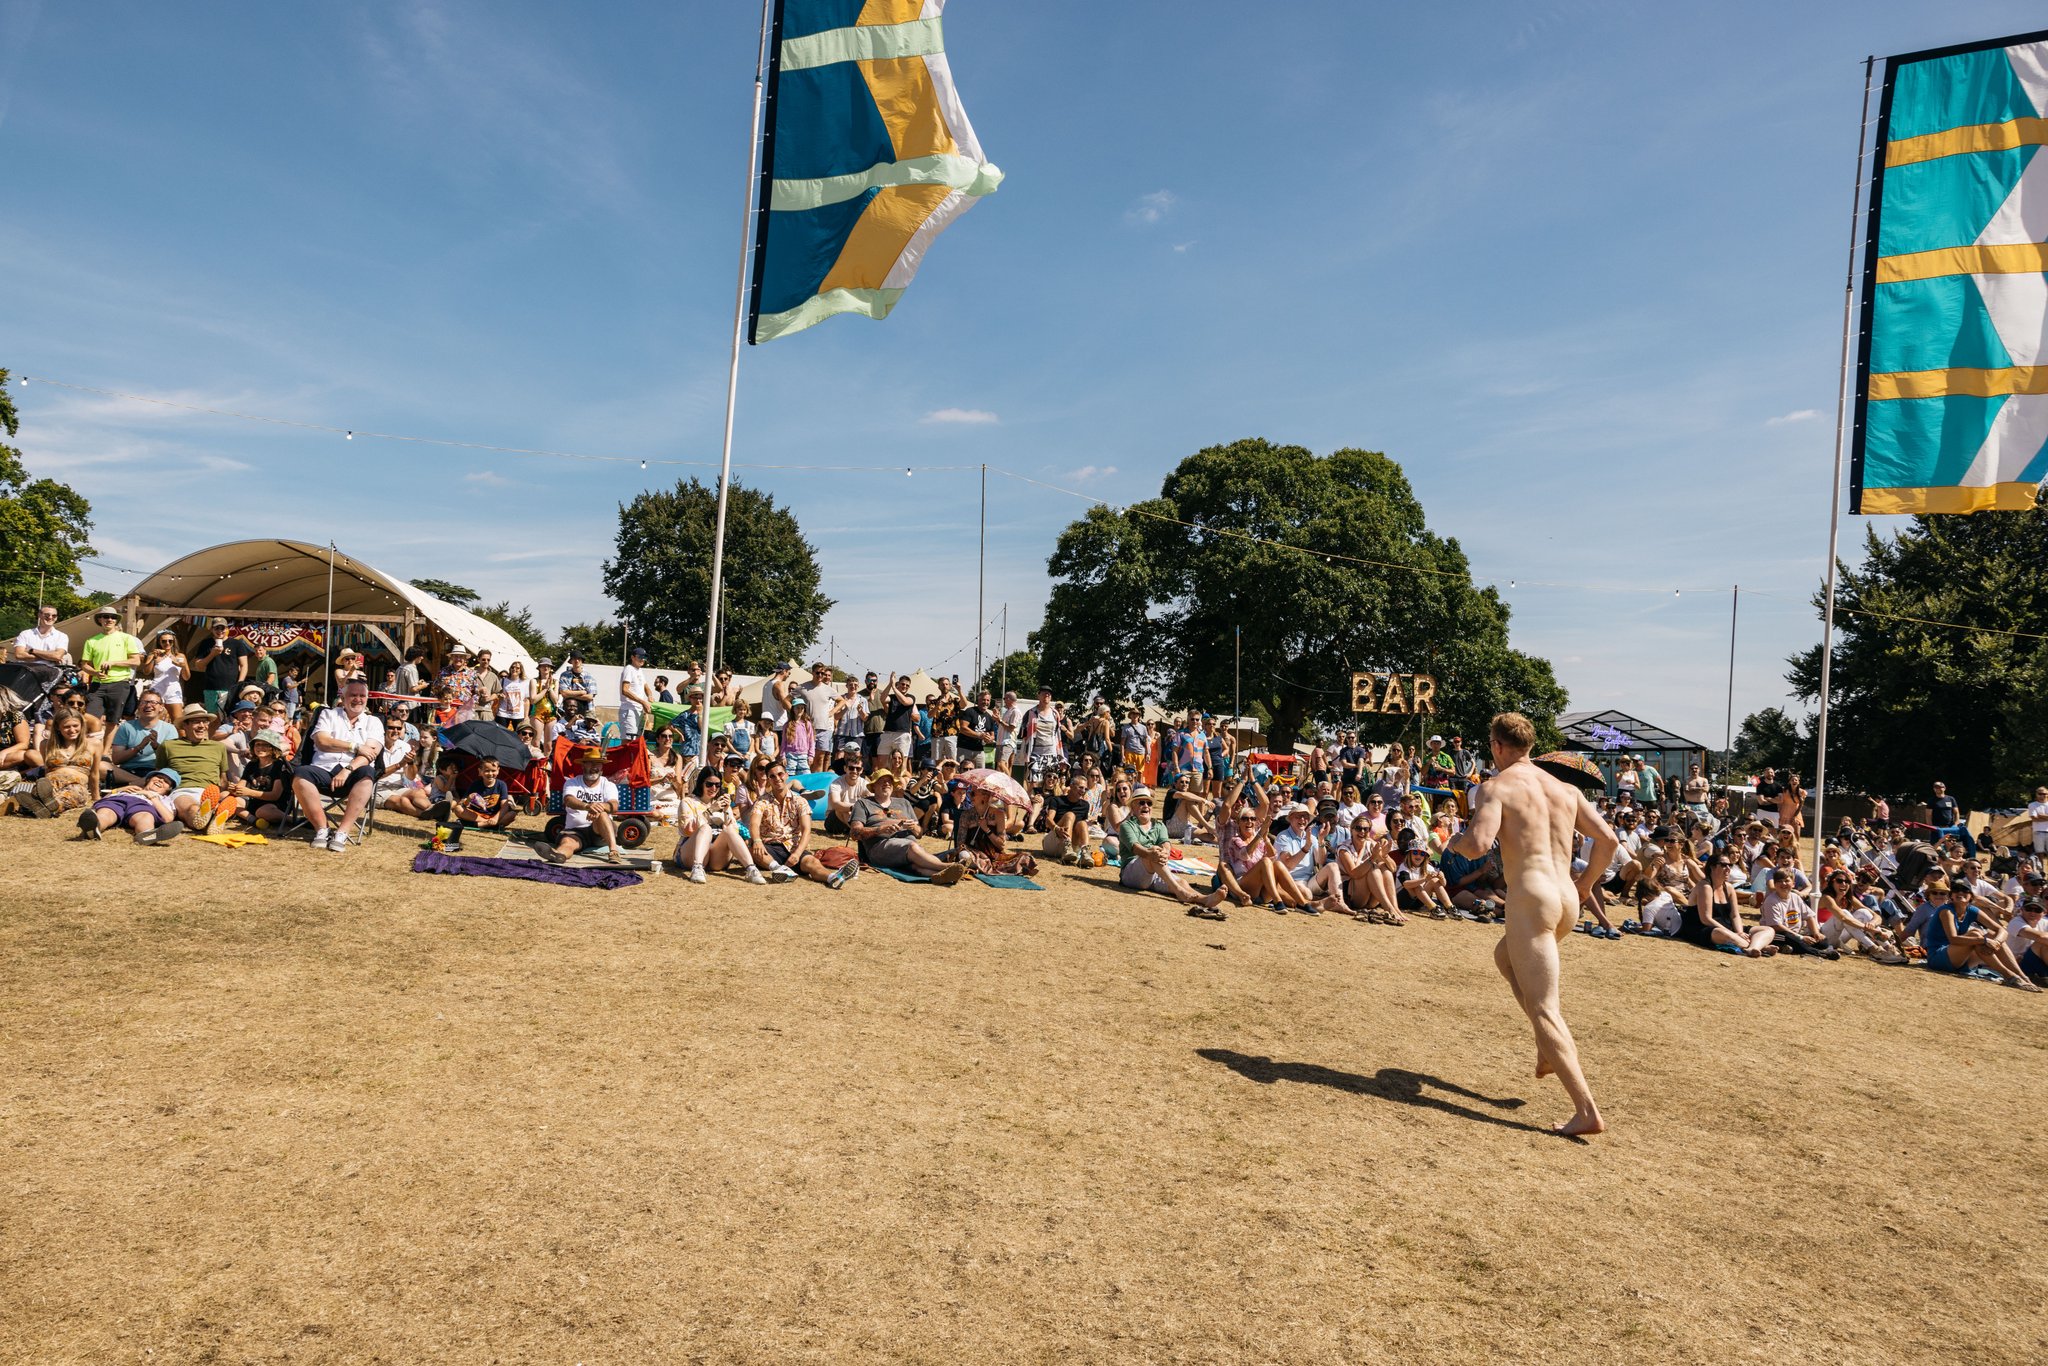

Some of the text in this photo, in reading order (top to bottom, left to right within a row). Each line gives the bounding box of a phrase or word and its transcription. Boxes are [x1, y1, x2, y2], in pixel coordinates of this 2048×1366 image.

[262, 621, 281, 630] THE
[241, 623, 304, 647] FOLK BARN
[1351, 671, 1437, 715] BAR
[1592, 725, 1622, 739] Bombay
[576, 789, 603, 802] CHOOSE
